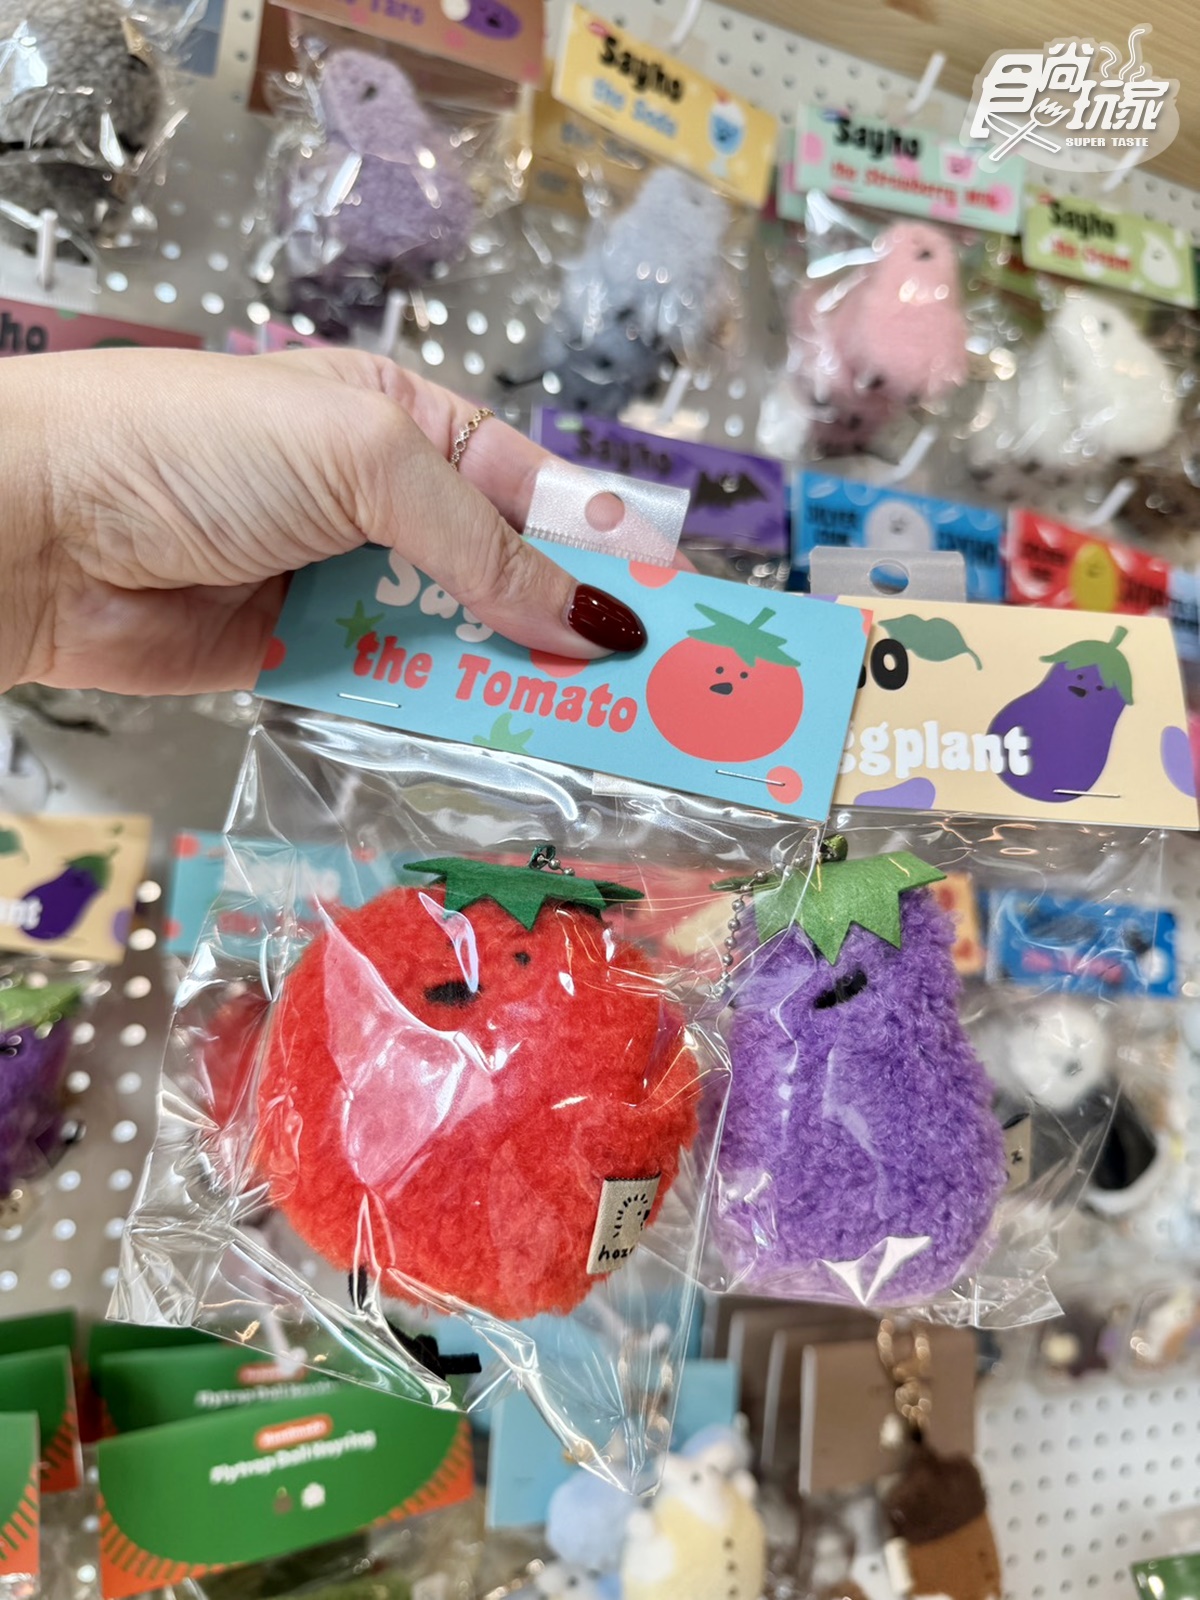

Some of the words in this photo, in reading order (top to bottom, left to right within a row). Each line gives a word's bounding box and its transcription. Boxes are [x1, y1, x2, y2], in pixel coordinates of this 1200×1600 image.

[599, 36, 684, 103] Sayho
[834, 116, 920, 160] Sayho
[1049, 201, 1117, 241] Sayho
[353, 630, 433, 689] the
[456, 653, 638, 733] Tomato
